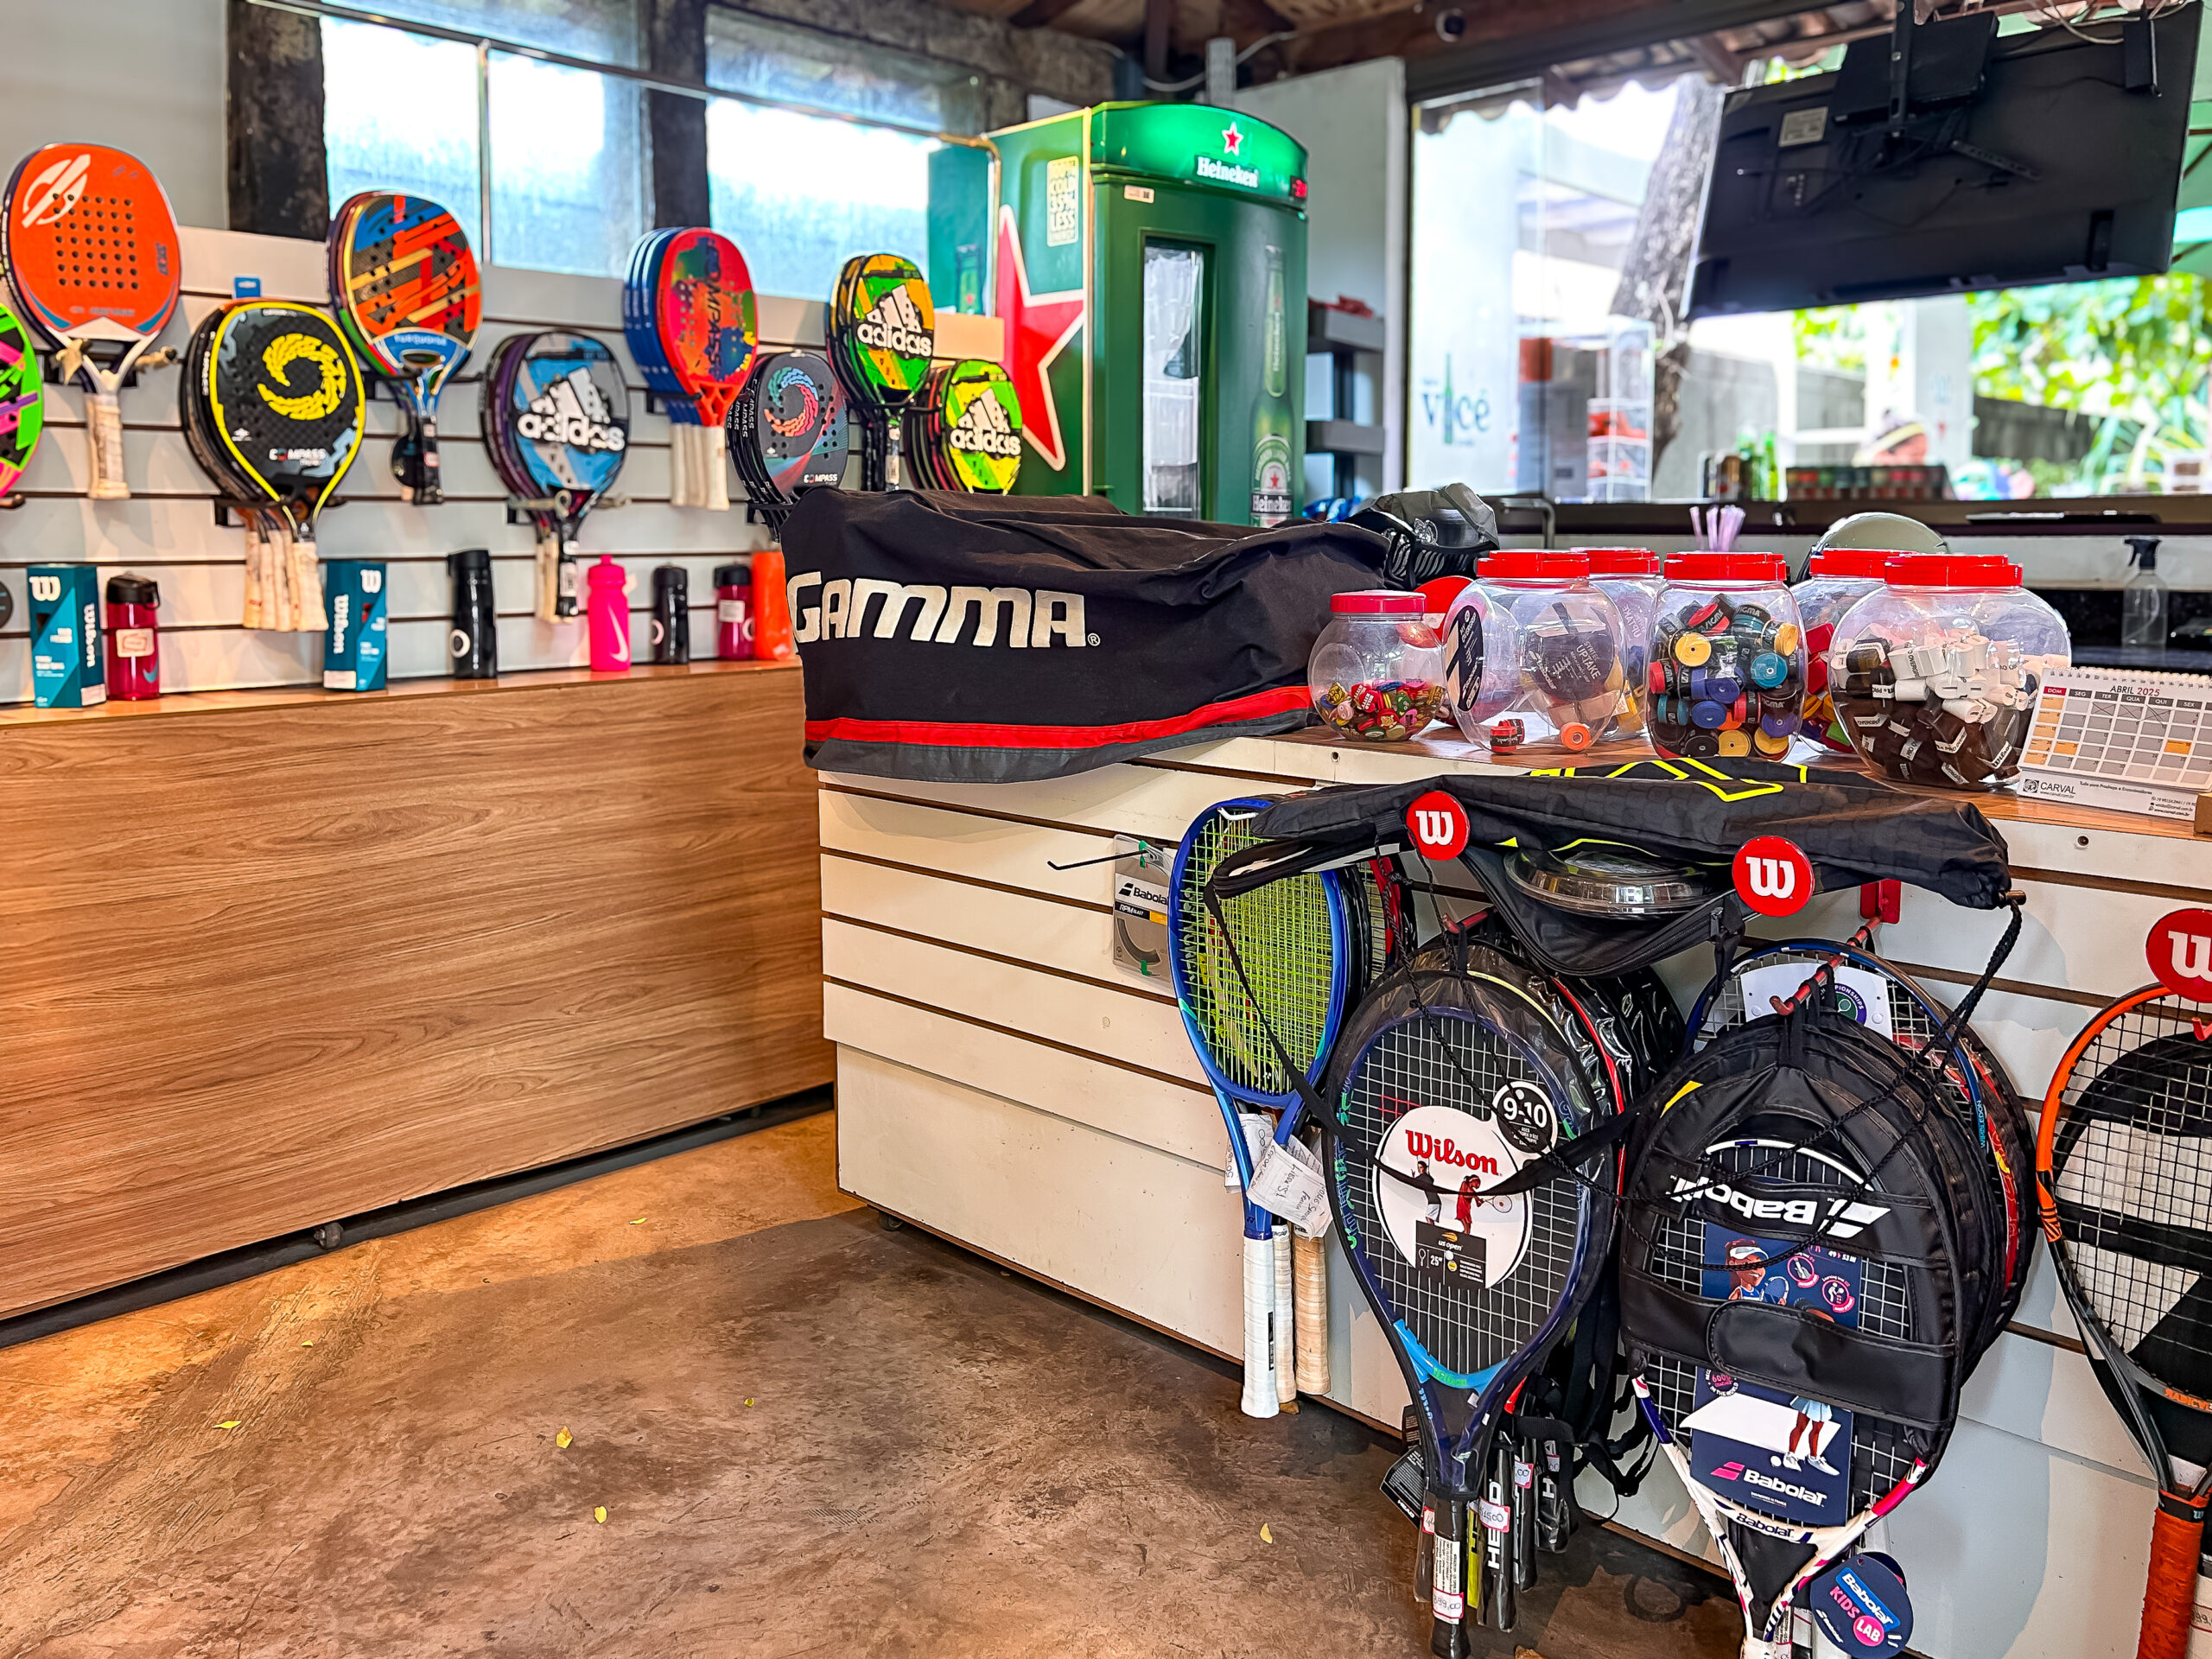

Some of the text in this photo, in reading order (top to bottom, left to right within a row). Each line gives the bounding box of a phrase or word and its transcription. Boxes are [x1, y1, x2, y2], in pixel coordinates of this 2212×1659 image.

[1197, 156, 1259, 188] Heineken
[857, 321, 932, 357] adidas
[518, 413, 626, 451] adidas
[950, 429, 1022, 455] adidas
[269, 448, 327, 461] COMPASS
[803, 474, 838, 484] COMPASS
[1576, 645, 1601, 680] UPTAKE
[2109, 685, 2160, 697] ABRIL 2025
[2040, 782, 2075, 795] CARVAL
[1119, 904, 1134, 913] RPM
[1405, 1129, 1499, 1176] Wilson
[1446, 1242, 1463, 1252] open
[1397, 1498, 1415, 1519] HEAD
[1487, 1478, 1502, 1570] HED
[1829, 1586, 1860, 1619] KIDS
[1856, 1619, 1881, 1643] LAB
